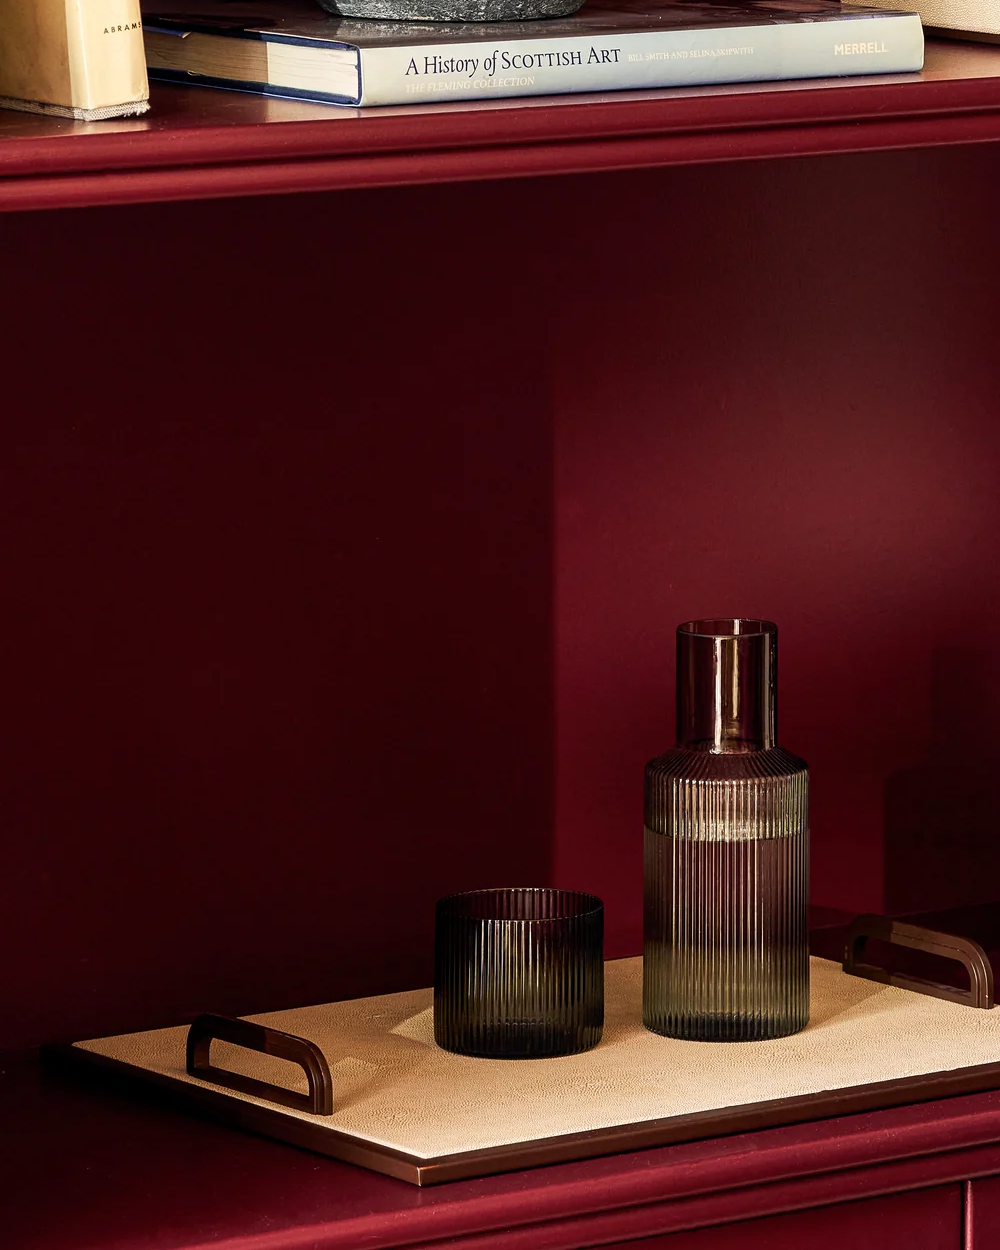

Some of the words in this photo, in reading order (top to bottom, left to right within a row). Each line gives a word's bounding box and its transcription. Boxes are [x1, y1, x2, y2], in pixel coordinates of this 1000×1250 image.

[645, 52, 669, 61] SMITH
[671, 50, 688, 59] AND
[689, 48, 716, 58] SELINA
[834, 41, 889, 55] MERRELL
[405, 57, 419, 76] A
[423, 55, 479, 78] History
[483, 50, 499, 77] of
[501, 51, 582, 70] SCOTTISH
[587, 46, 621, 65] ART
[405, 83, 426, 94] THE
[427, 80, 472, 92] FLEMING
[473, 76, 536, 89] COLLECTION
